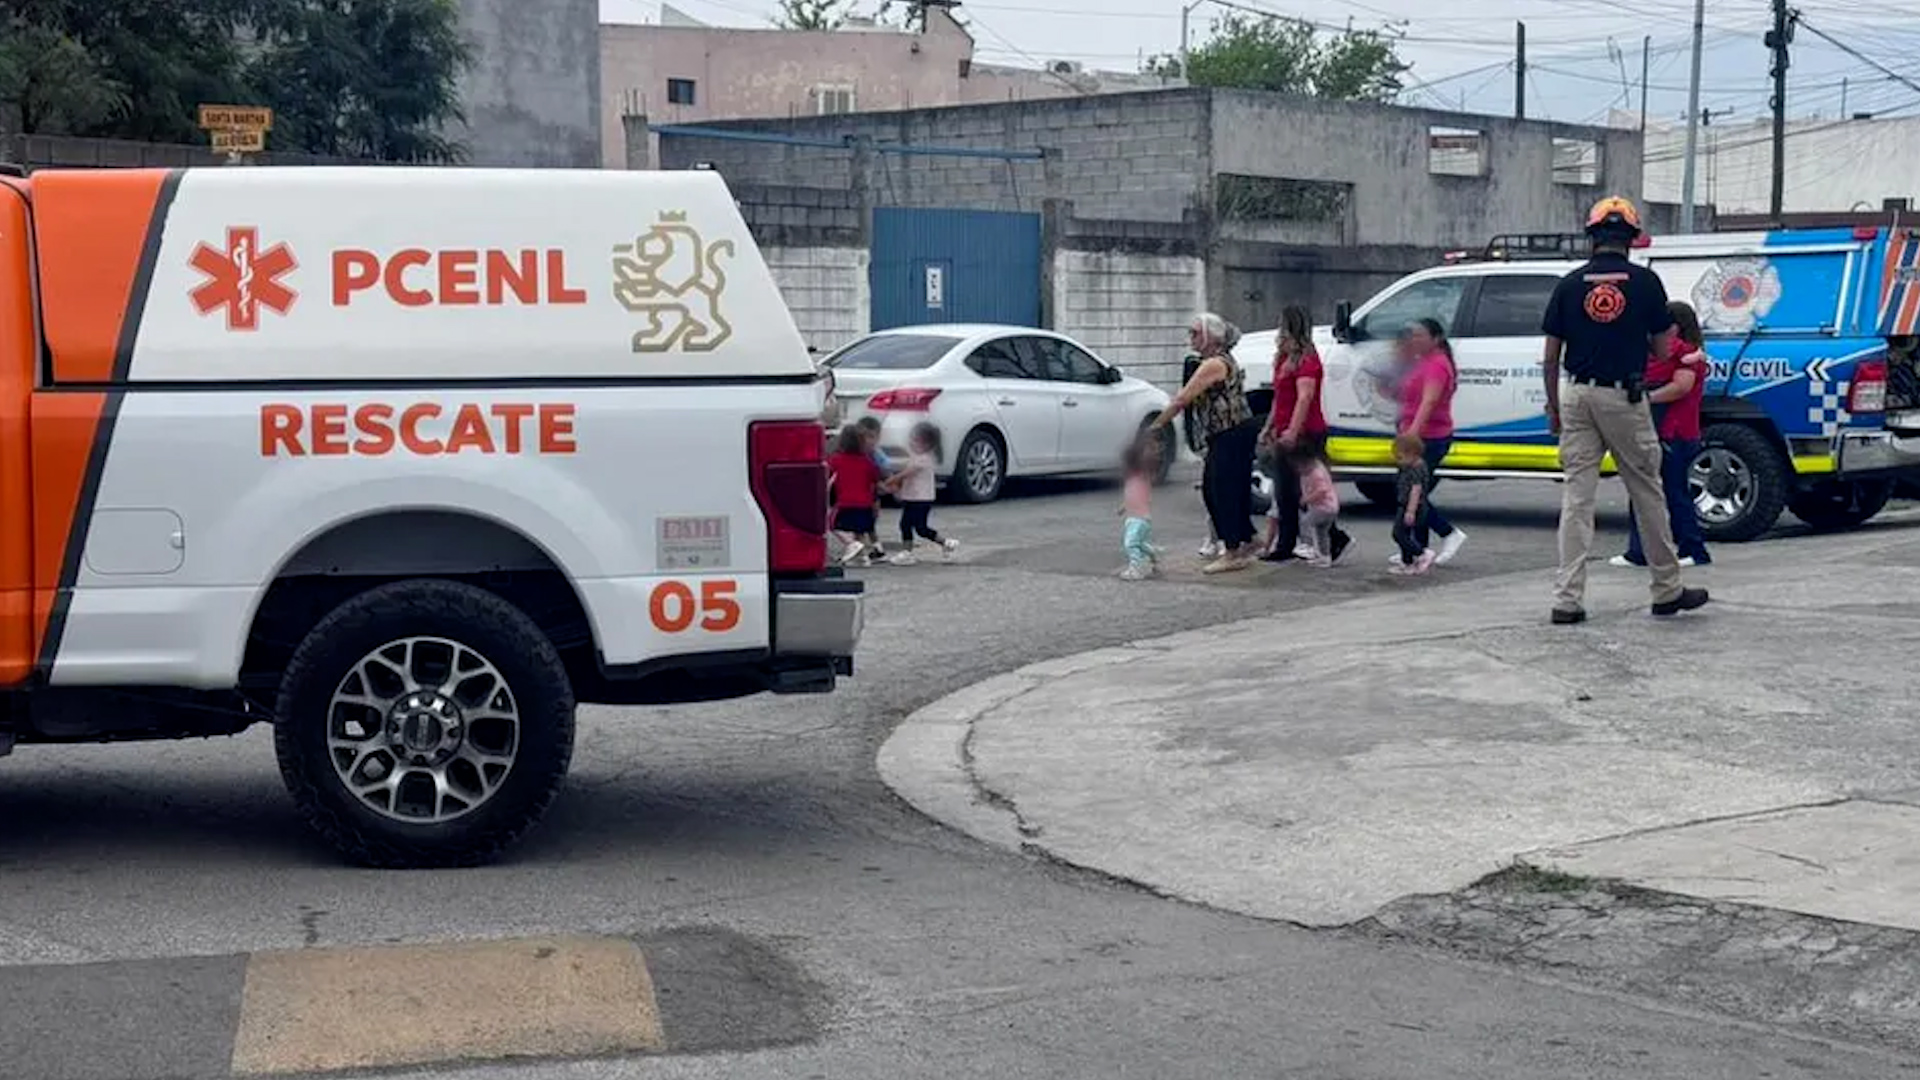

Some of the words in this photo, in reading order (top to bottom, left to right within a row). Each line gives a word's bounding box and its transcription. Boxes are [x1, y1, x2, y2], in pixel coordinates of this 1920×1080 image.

[332, 249, 587, 306] PCENL
[1739, 361, 1793, 377] CIVIL
[261, 402, 577, 456] RESCATE
[649, 580, 740, 632] 05
